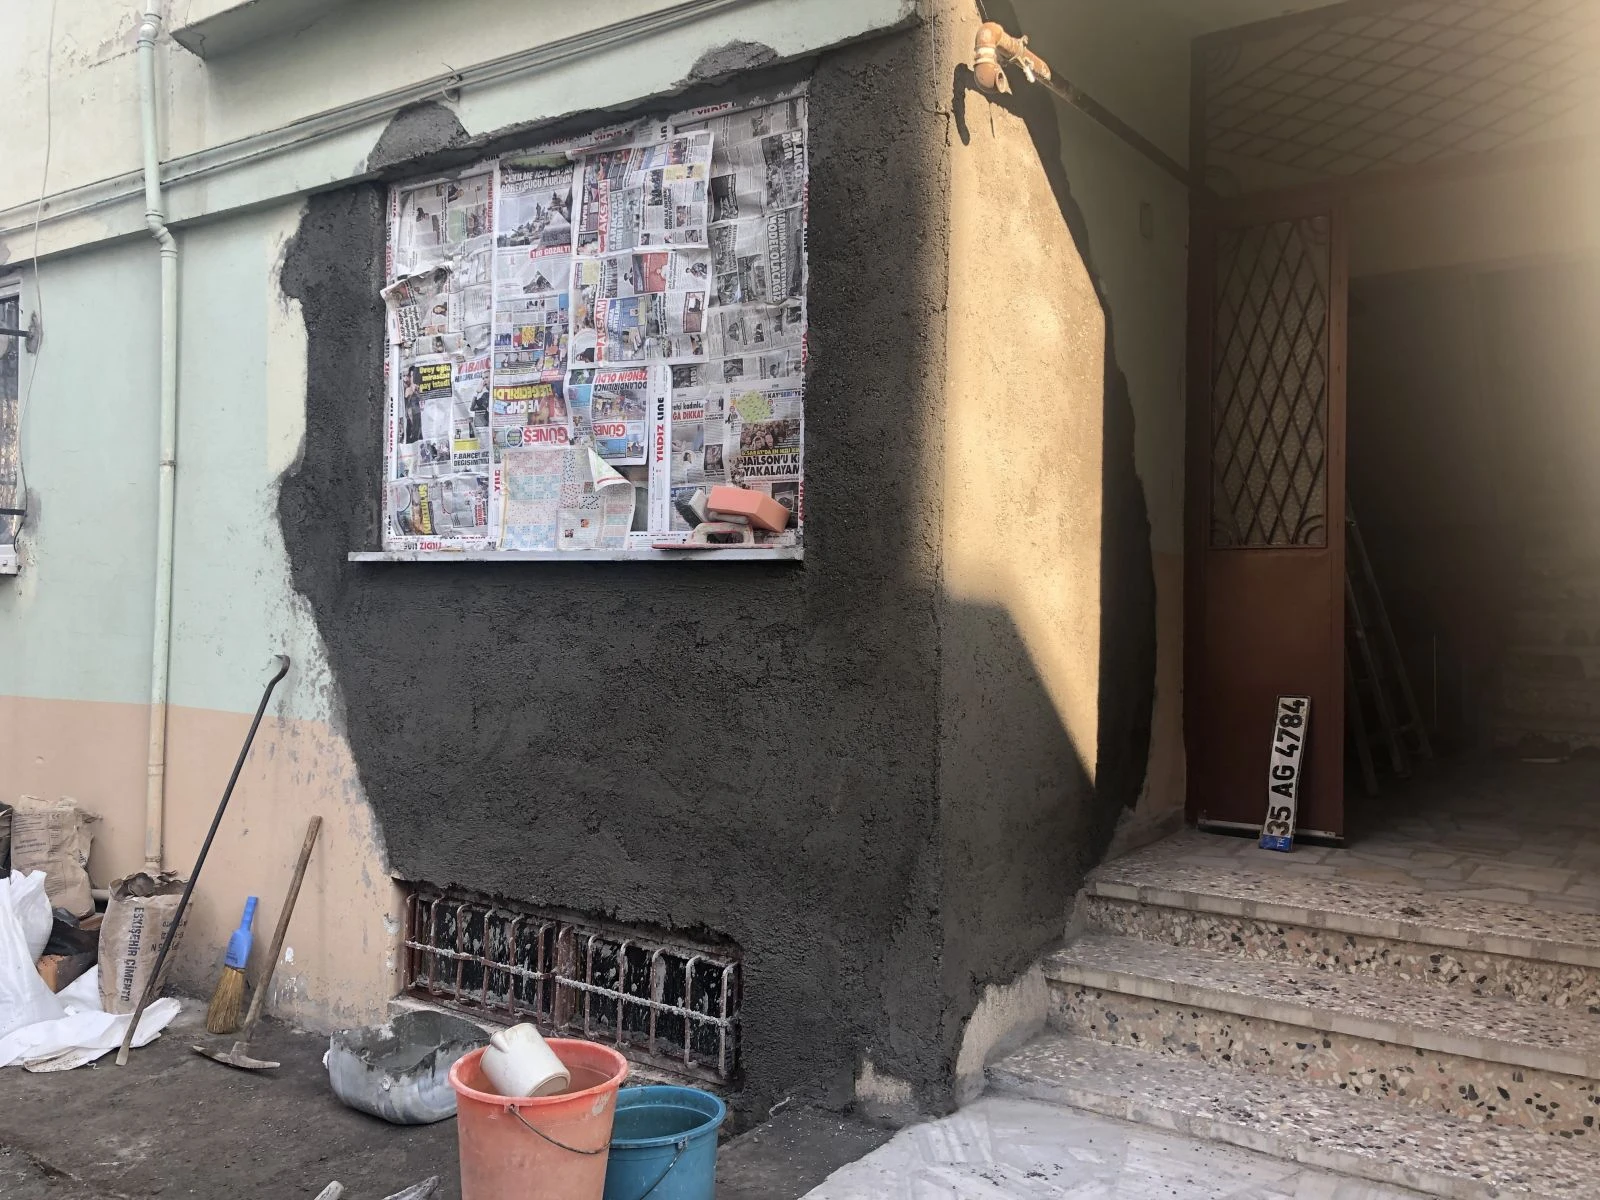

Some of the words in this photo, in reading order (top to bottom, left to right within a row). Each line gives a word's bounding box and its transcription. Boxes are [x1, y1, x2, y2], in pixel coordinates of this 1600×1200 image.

[656, 424, 665, 462] YILDIZ
[1274, 699, 1306, 758] 4784
[1271, 765, 1295, 798] AG
[1266, 805, 1292, 836] 35
